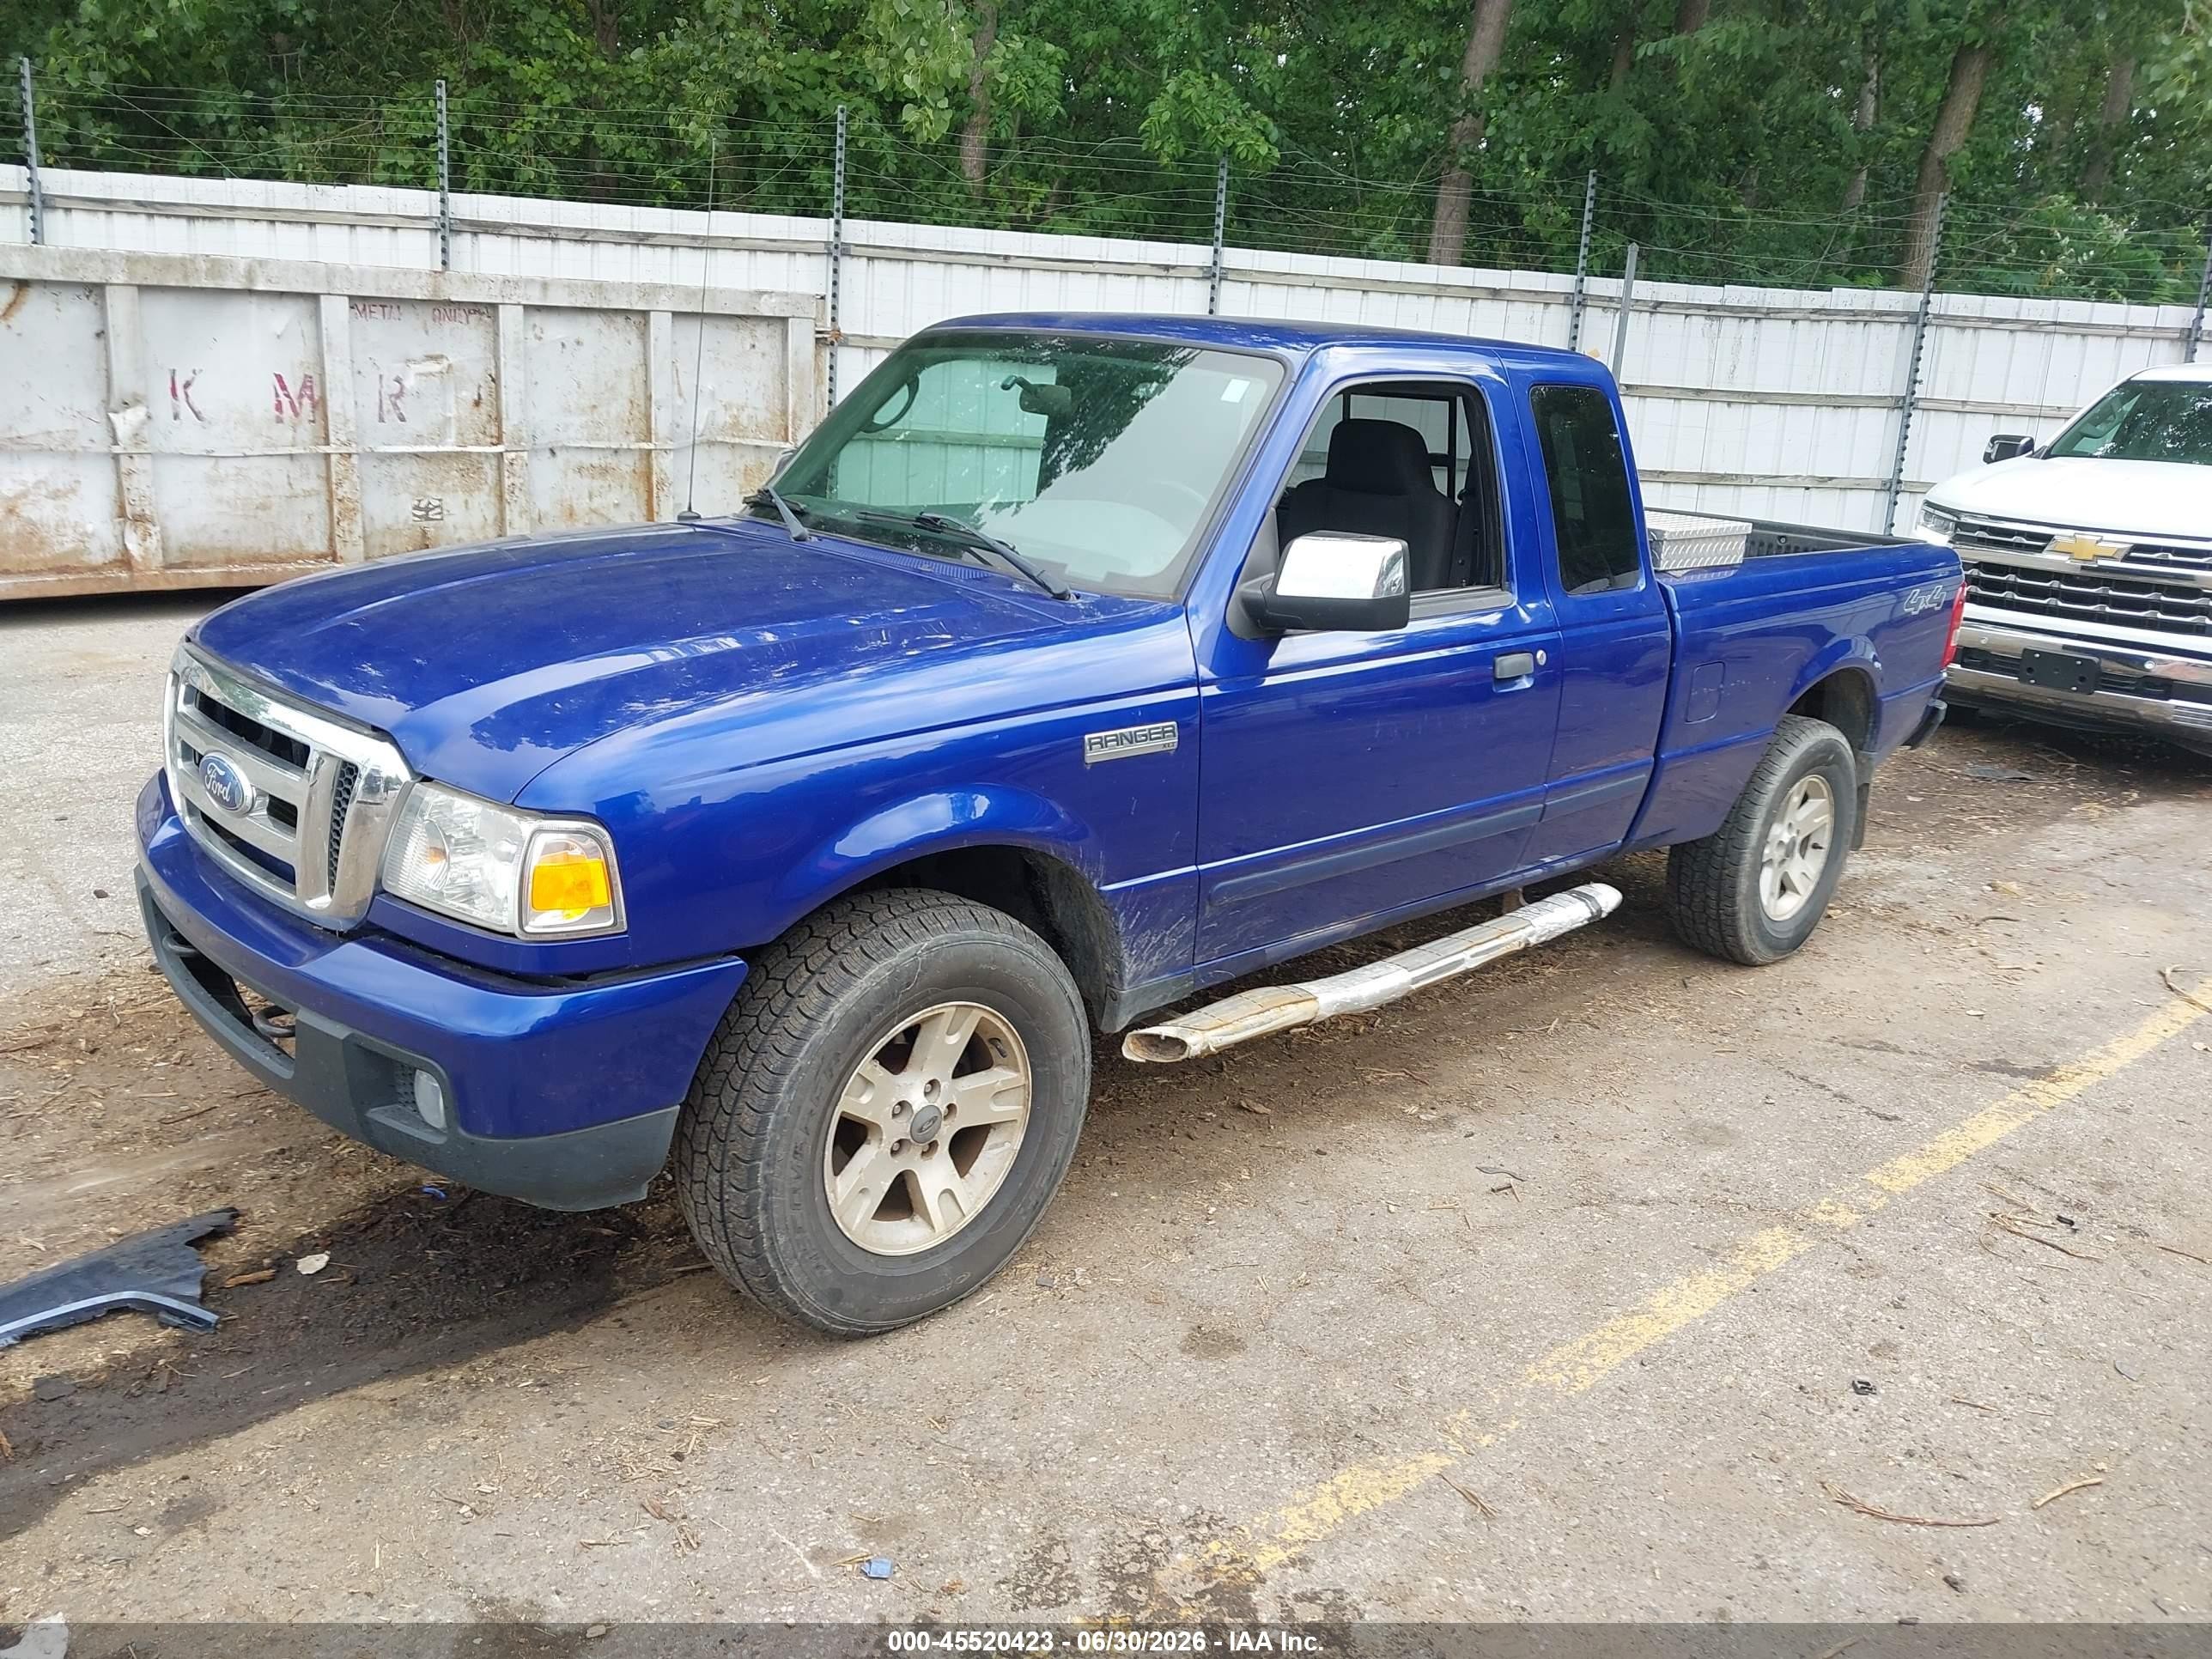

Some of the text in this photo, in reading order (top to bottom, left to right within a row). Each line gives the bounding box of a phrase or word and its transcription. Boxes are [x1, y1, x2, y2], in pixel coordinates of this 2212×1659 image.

[1903, 585, 1947, 615] 4x4
[1087, 725, 1176, 750] RANGER
[204, 763, 231, 801] Ford
